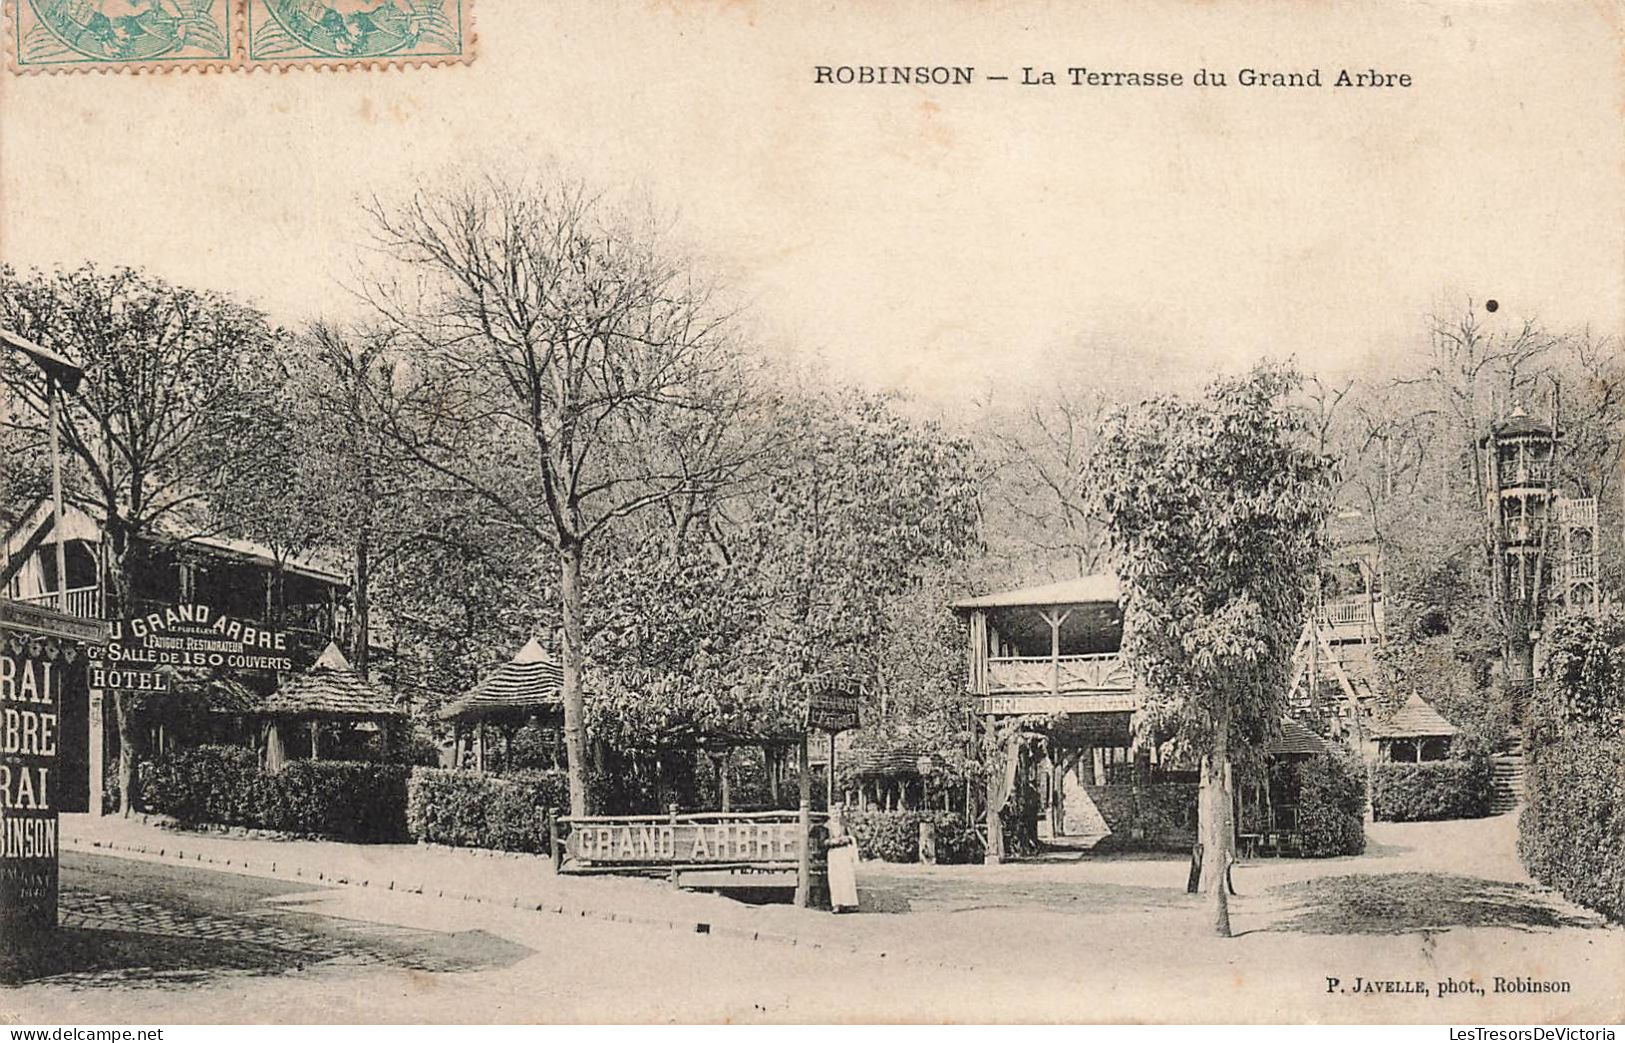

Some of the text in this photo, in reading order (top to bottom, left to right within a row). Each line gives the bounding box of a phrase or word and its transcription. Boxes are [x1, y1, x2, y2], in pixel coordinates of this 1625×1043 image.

[814, 66, 976, 85] ROBINSON
[1021, 67, 1056, 86] La
[1068, 67, 1184, 87] Terrasse
[1193, 67, 1227, 87] du
[1237, 67, 1322, 87] Grand
[1334, 67, 1413, 87] Arbre
[131, 604, 210, 638] GRAND
[213, 615, 287, 650] ARBRE
[108, 643, 157, 663] SALLE
[160, 652, 179, 664] DE
[182, 654, 224, 666] 150
[228, 655, 292, 670] COUVERTS
[187, 637, 244, 654] RESTAURATEUR
[578, 825, 796, 860] GRAND ARBRE
[1326, 976, 1572, 998] P. JAVELLE, phot., Robinson
